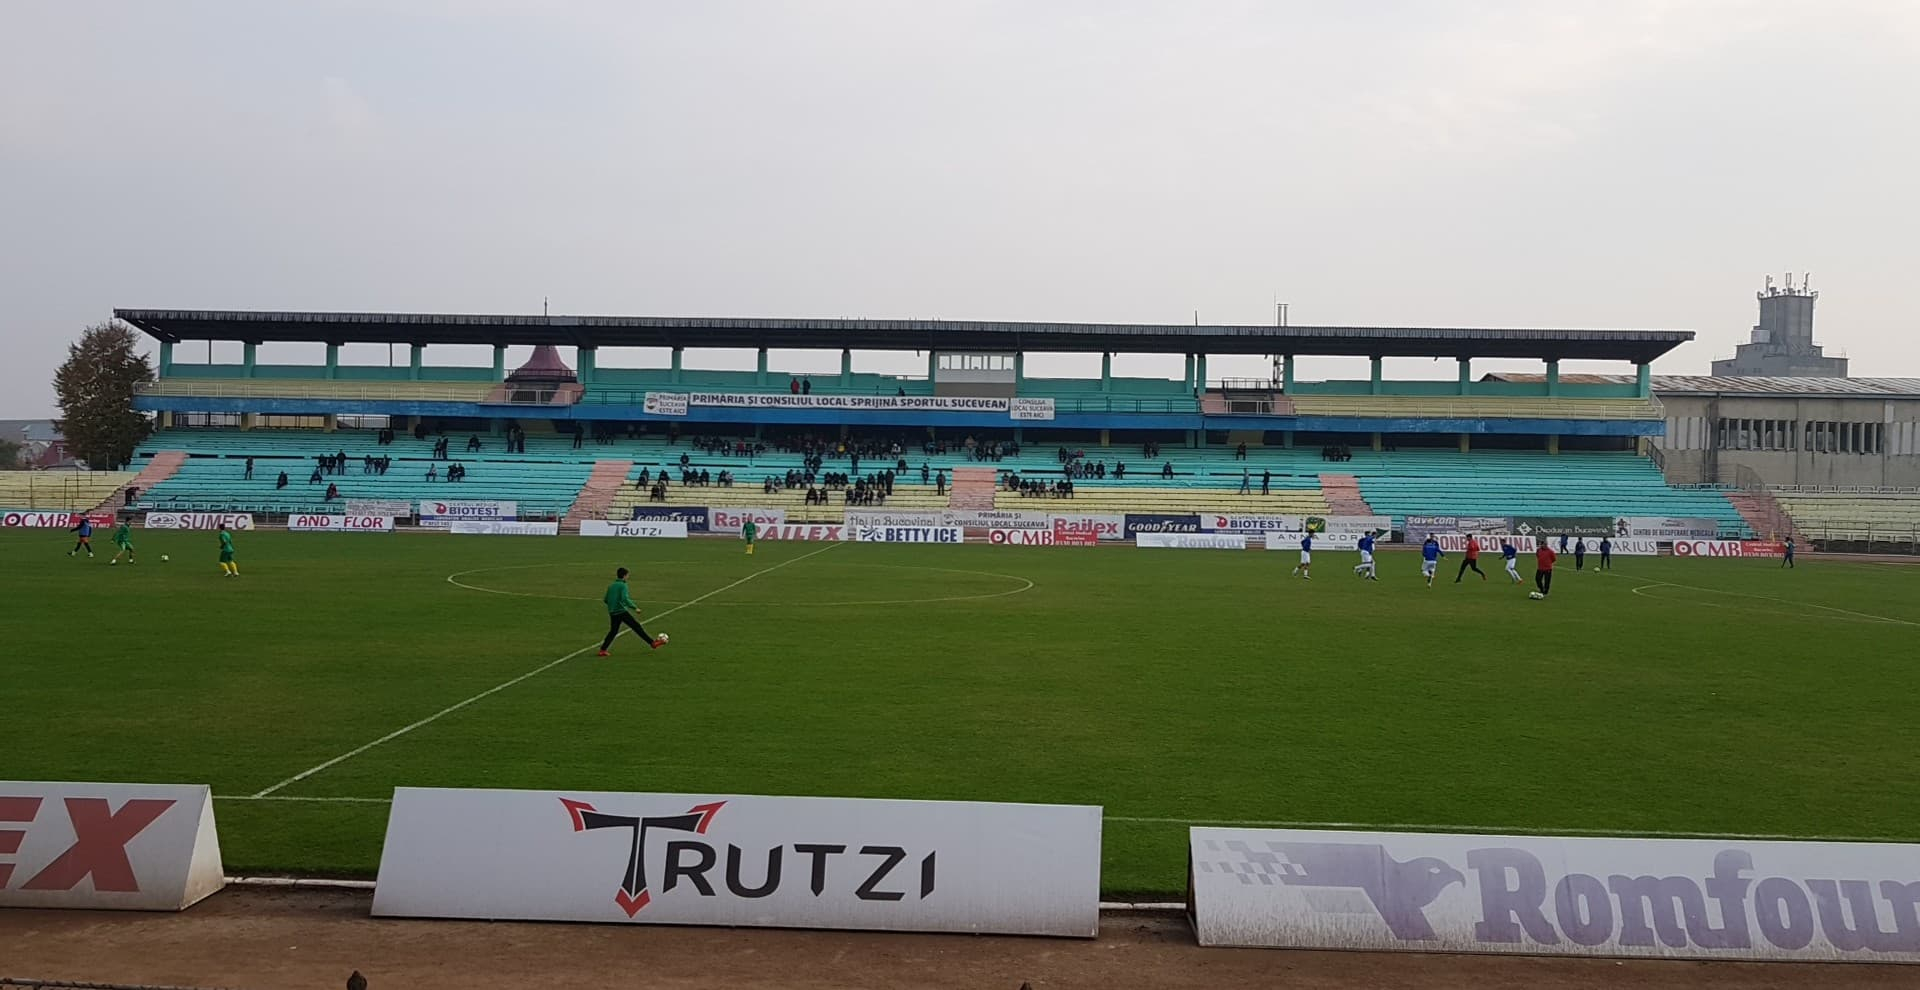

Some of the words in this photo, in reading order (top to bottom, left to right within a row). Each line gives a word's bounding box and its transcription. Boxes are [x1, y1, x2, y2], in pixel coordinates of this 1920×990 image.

[760, 396, 814, 406] CONSILIUL
[816, 397, 848, 406] LOCAL
[900, 398, 949, 408] SPORTUL
[952, 398, 1007, 409] SUCEVEAN
[450, 507, 500, 515] BIOTEST
[178, 514, 248, 530] SUMEC
[297, 516, 330, 527] AND
[344, 516, 383, 528] FLOR
[637, 512, 704, 524] GOODYEAR
[1230, 520, 1282, 528] BIOTEST
[606, 522, 662, 536] TRUTZI
[1054, 518, 1118, 534] Railex
[1128, 520, 1197, 532] GOODYEAR
[886, 528, 930, 542] BETTY
[934, 528, 957, 542] ICE
[558, 797, 936, 918] TRUTZI
[1466, 847, 1920, 953] Romfour
